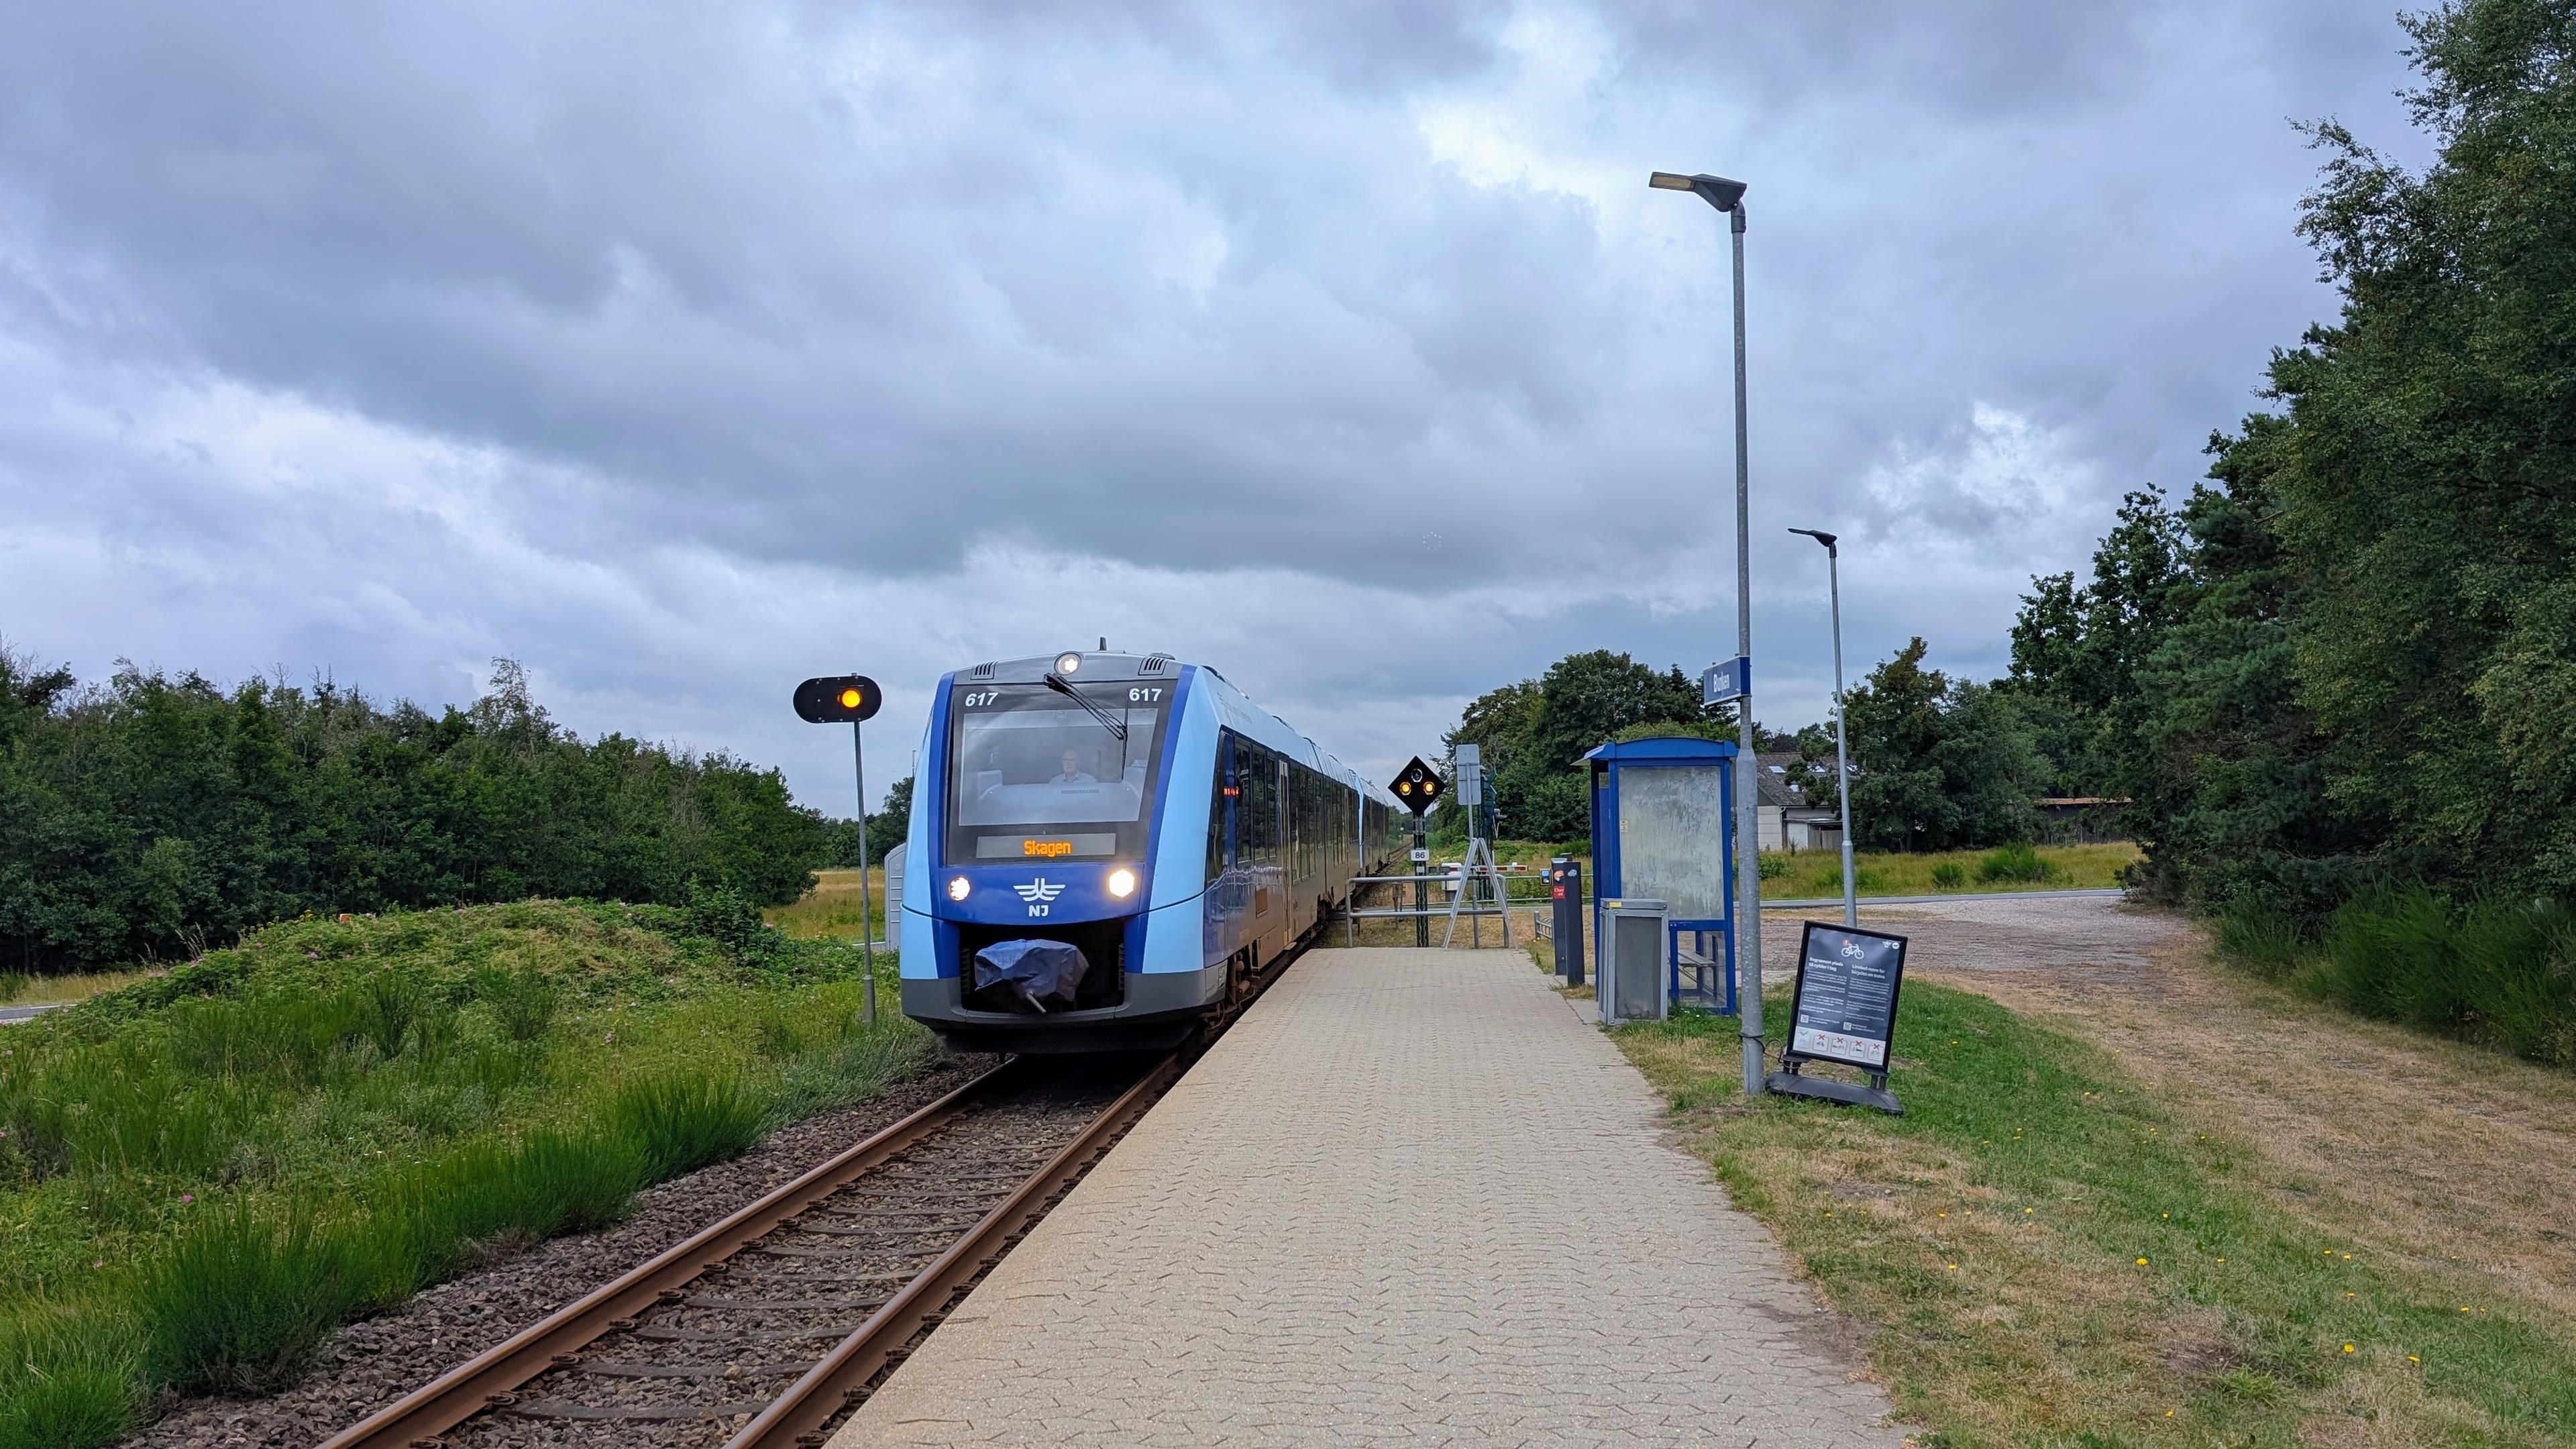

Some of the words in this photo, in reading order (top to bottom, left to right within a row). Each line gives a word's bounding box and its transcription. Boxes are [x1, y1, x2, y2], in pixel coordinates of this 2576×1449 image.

[965, 692, 998, 706] 617
[1129, 688, 1162, 702] 617
[1024, 840, 1072, 857] Skagen
[1028, 905, 1049, 917] NJ
